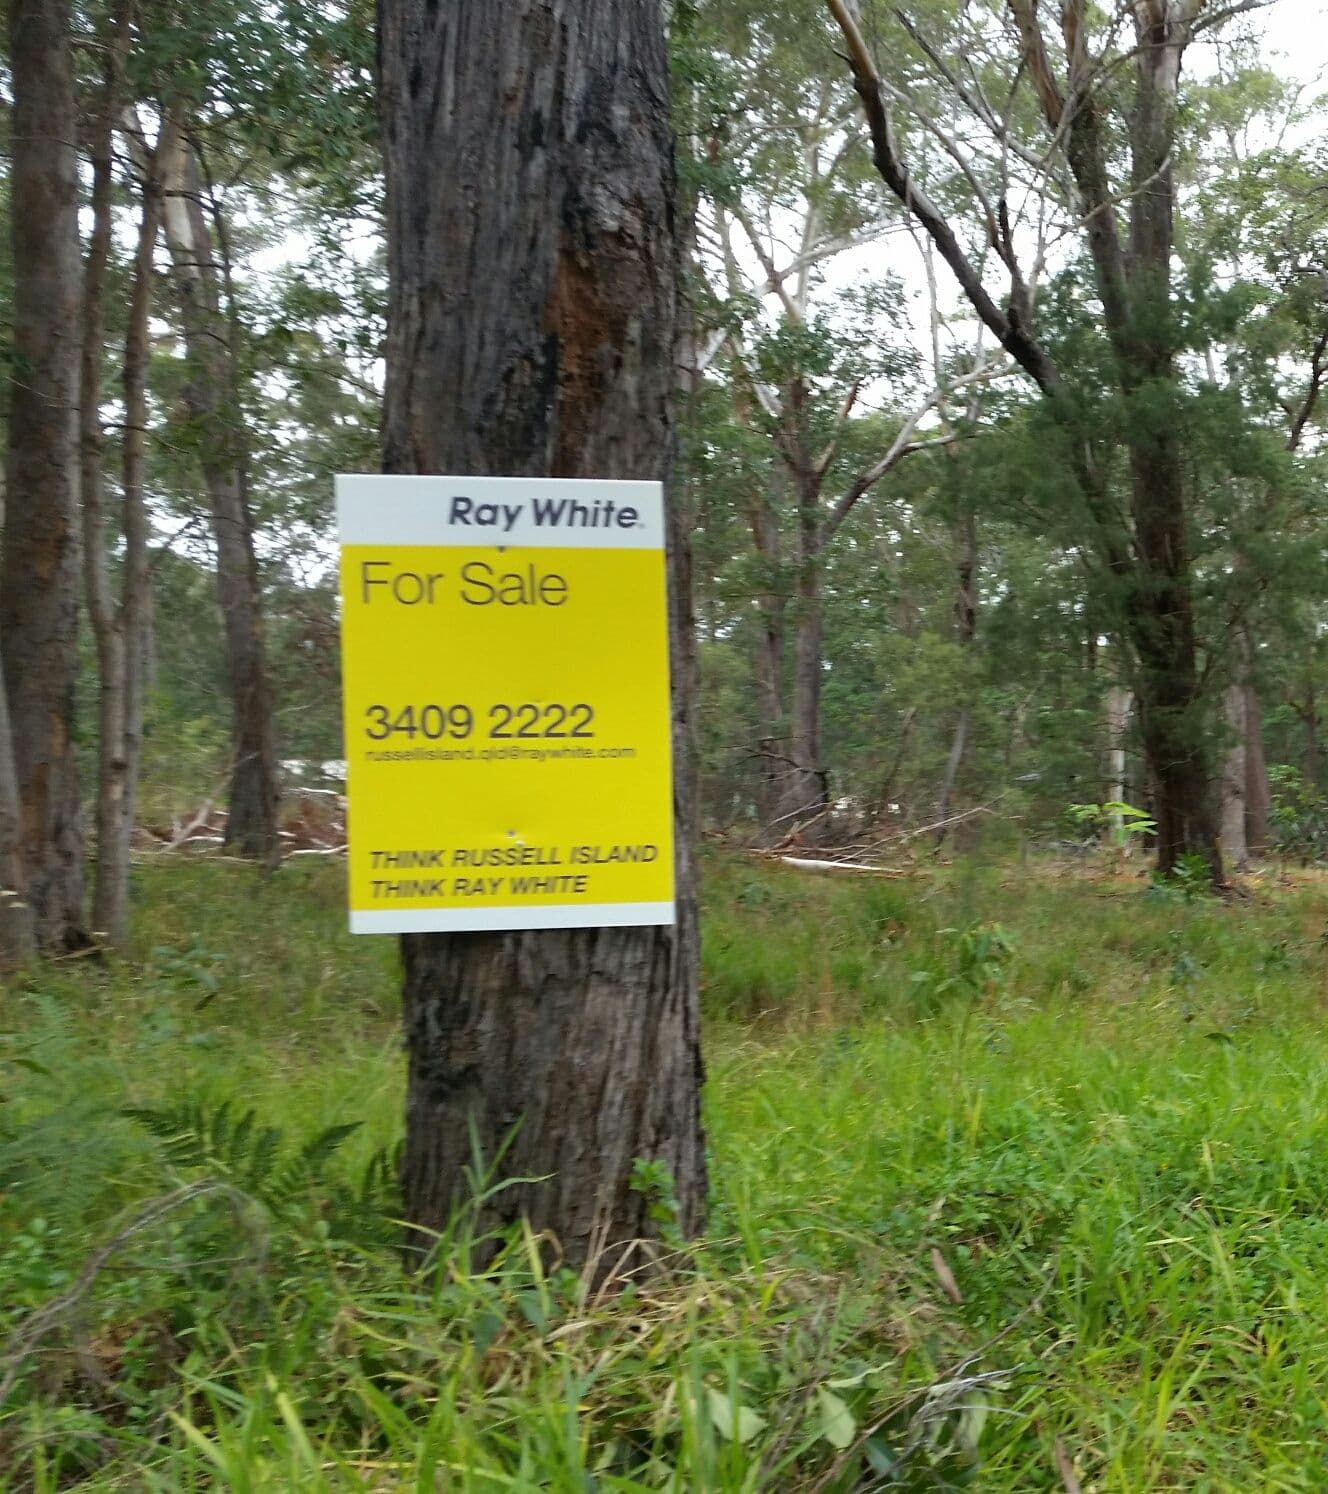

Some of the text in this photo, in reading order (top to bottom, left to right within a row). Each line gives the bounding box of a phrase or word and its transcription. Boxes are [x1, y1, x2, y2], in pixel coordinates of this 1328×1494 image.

[448, 496, 639, 532] Ray White
[360, 561, 568, 606] For Sale
[365, 703, 594, 740] 3409 2222
[369, 845, 658, 869] THINK RUSSELL ISLAND
[370, 874, 589, 898] THINK RAY WHITE
